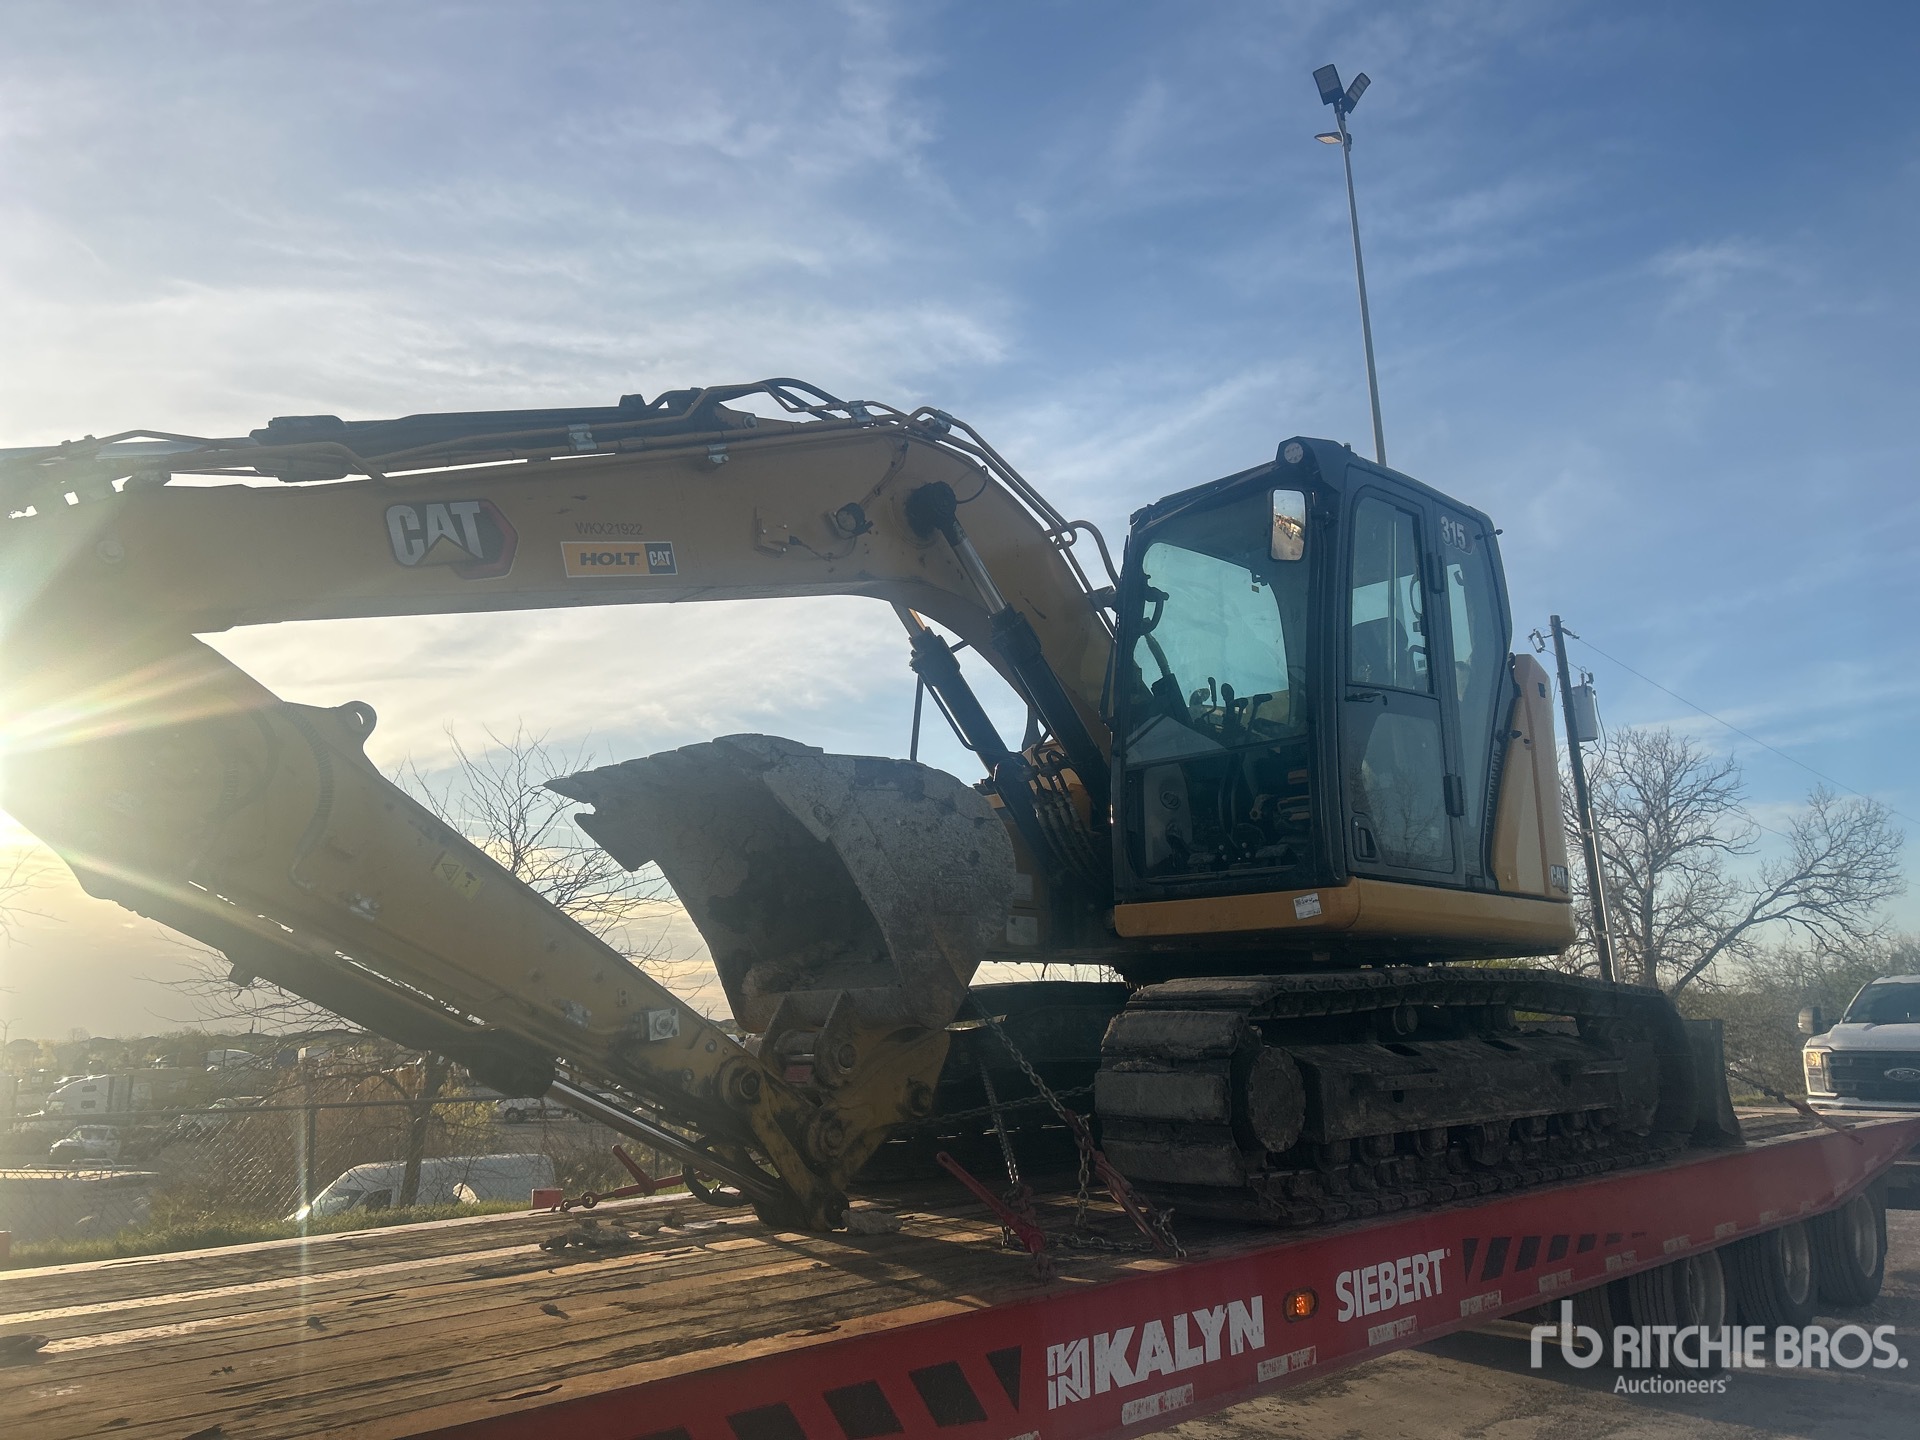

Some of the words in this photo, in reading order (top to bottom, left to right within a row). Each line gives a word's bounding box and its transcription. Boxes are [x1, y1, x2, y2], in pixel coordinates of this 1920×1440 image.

[386, 501, 484, 566] CAT
[575, 522, 644, 536] WKX21922
[1440, 516, 1466, 550] 315
[580, 552, 640, 566] HOLT
[649, 550, 671, 567] CAT
[1335, 1248, 1446, 1323] SIEBERT
[1094, 1295, 1265, 1395] KALYN
